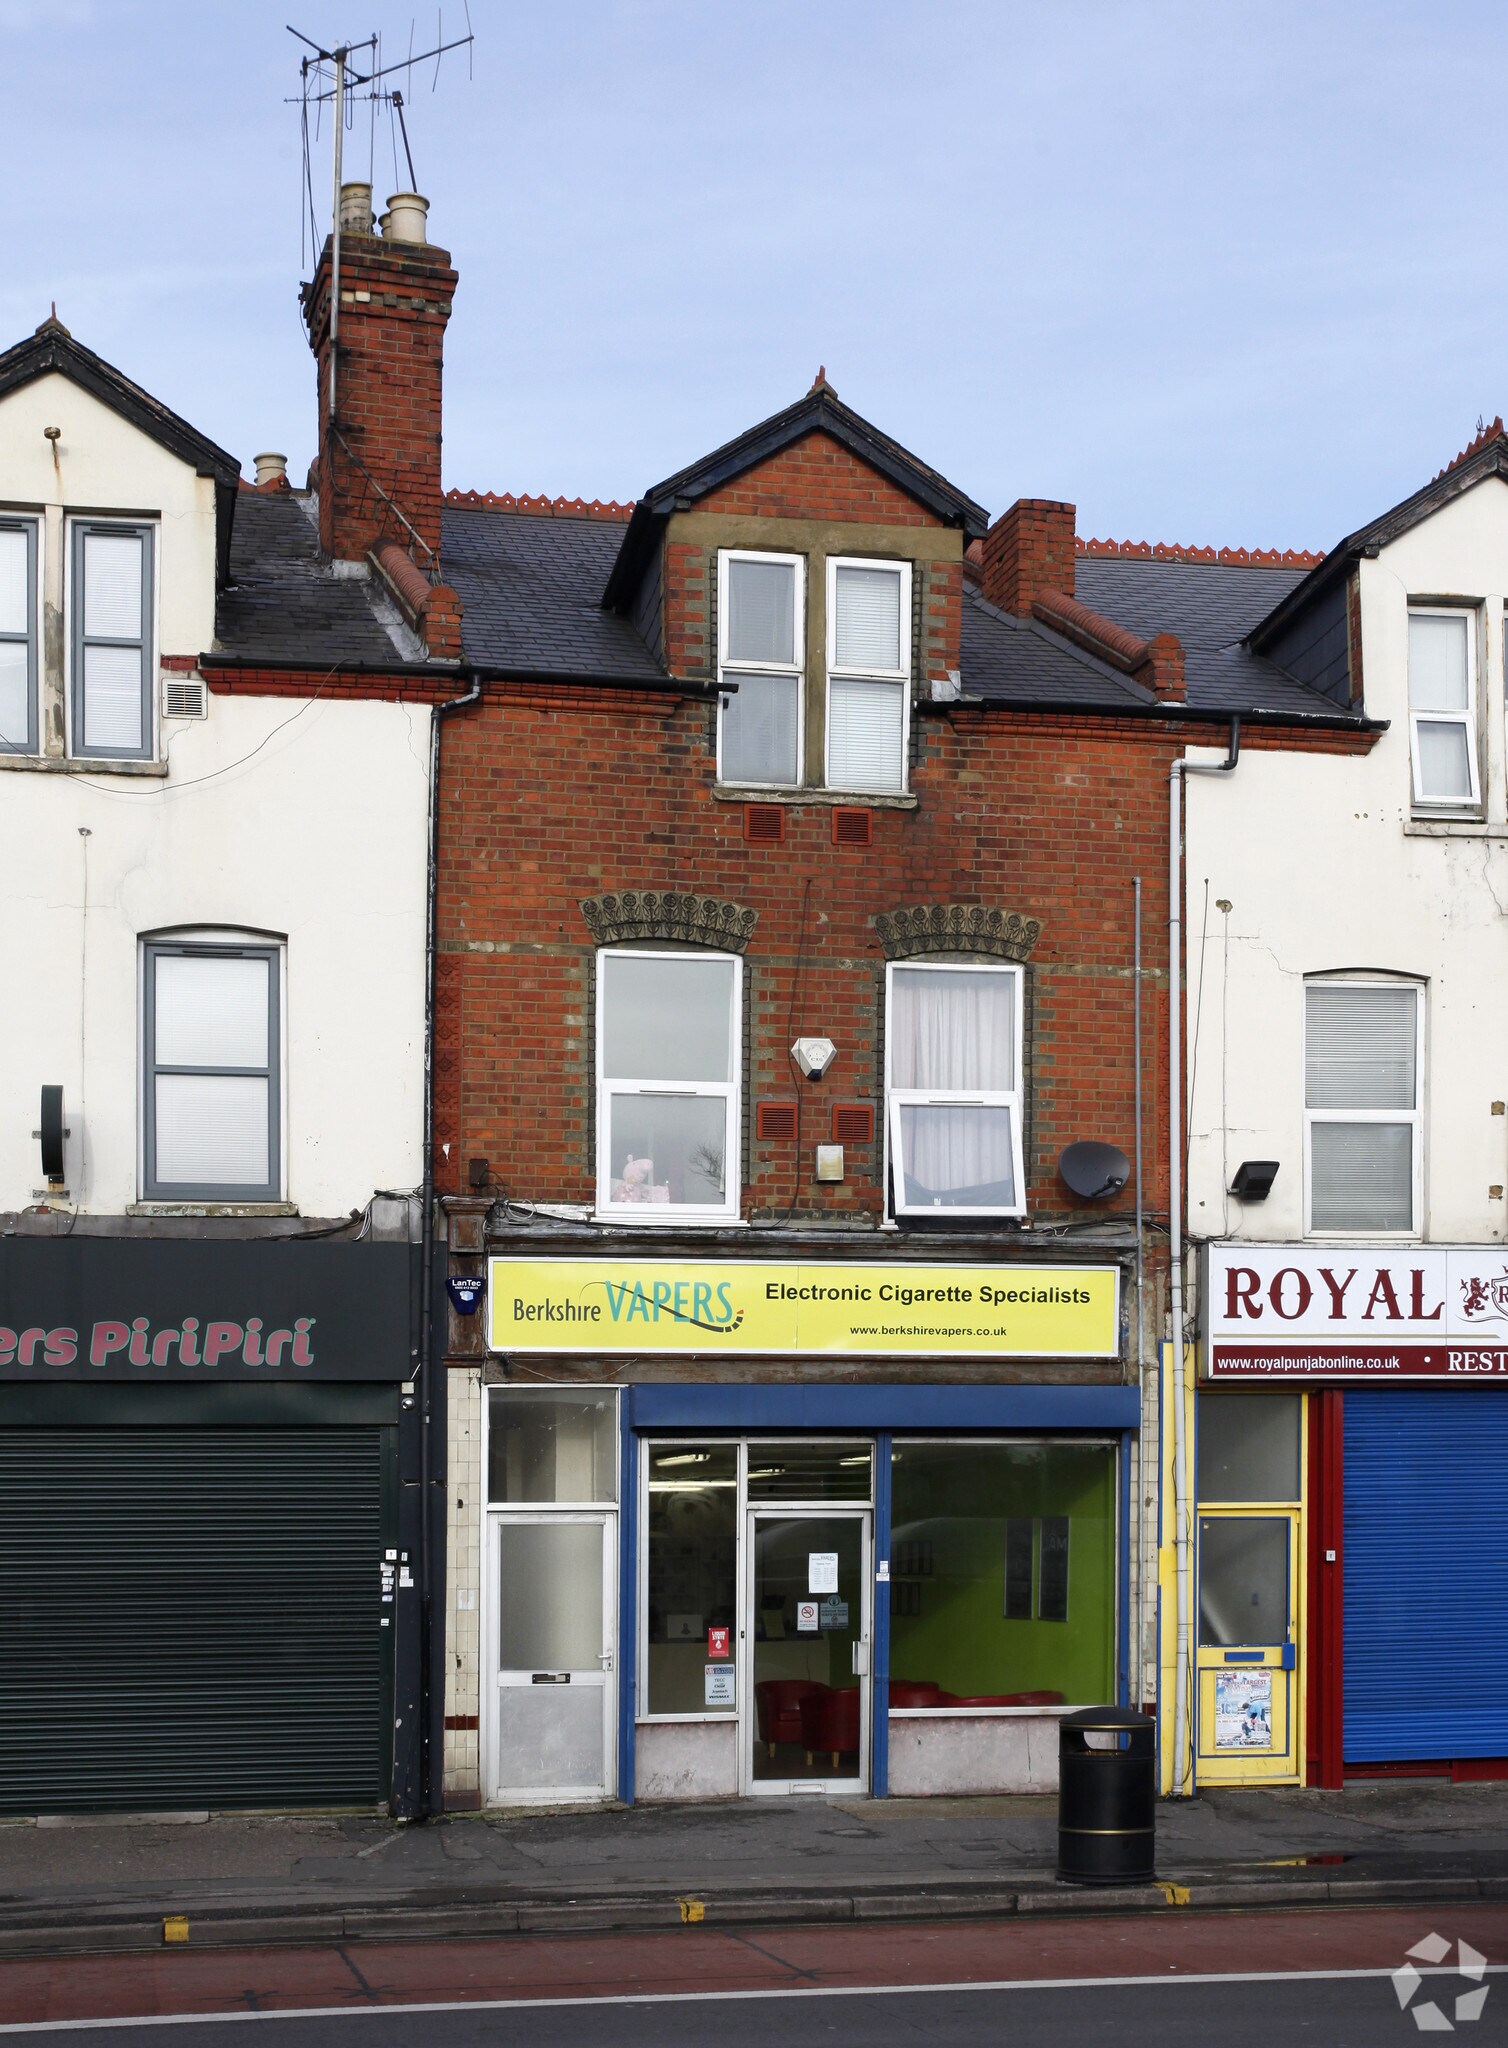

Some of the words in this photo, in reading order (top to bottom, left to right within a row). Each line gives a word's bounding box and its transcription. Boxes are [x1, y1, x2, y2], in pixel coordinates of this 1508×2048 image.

[513, 1298, 601, 1322] Berkshire
[605, 1280, 733, 1323] VAPERS
[765, 1283, 872, 1301] Electronic
[879, 1284, 973, 1305] Cigarette
[979, 1286, 1091, 1306] Specialists
[1223, 1267, 1445, 1320] ROYAL
[89, 1317, 314, 1366] PiriPiri
[850, 1326, 1007, 1338] www.berkshirevapers.co.uk
[1217, 1356, 1400, 1372] www.royalpunjabonline.co.uk
